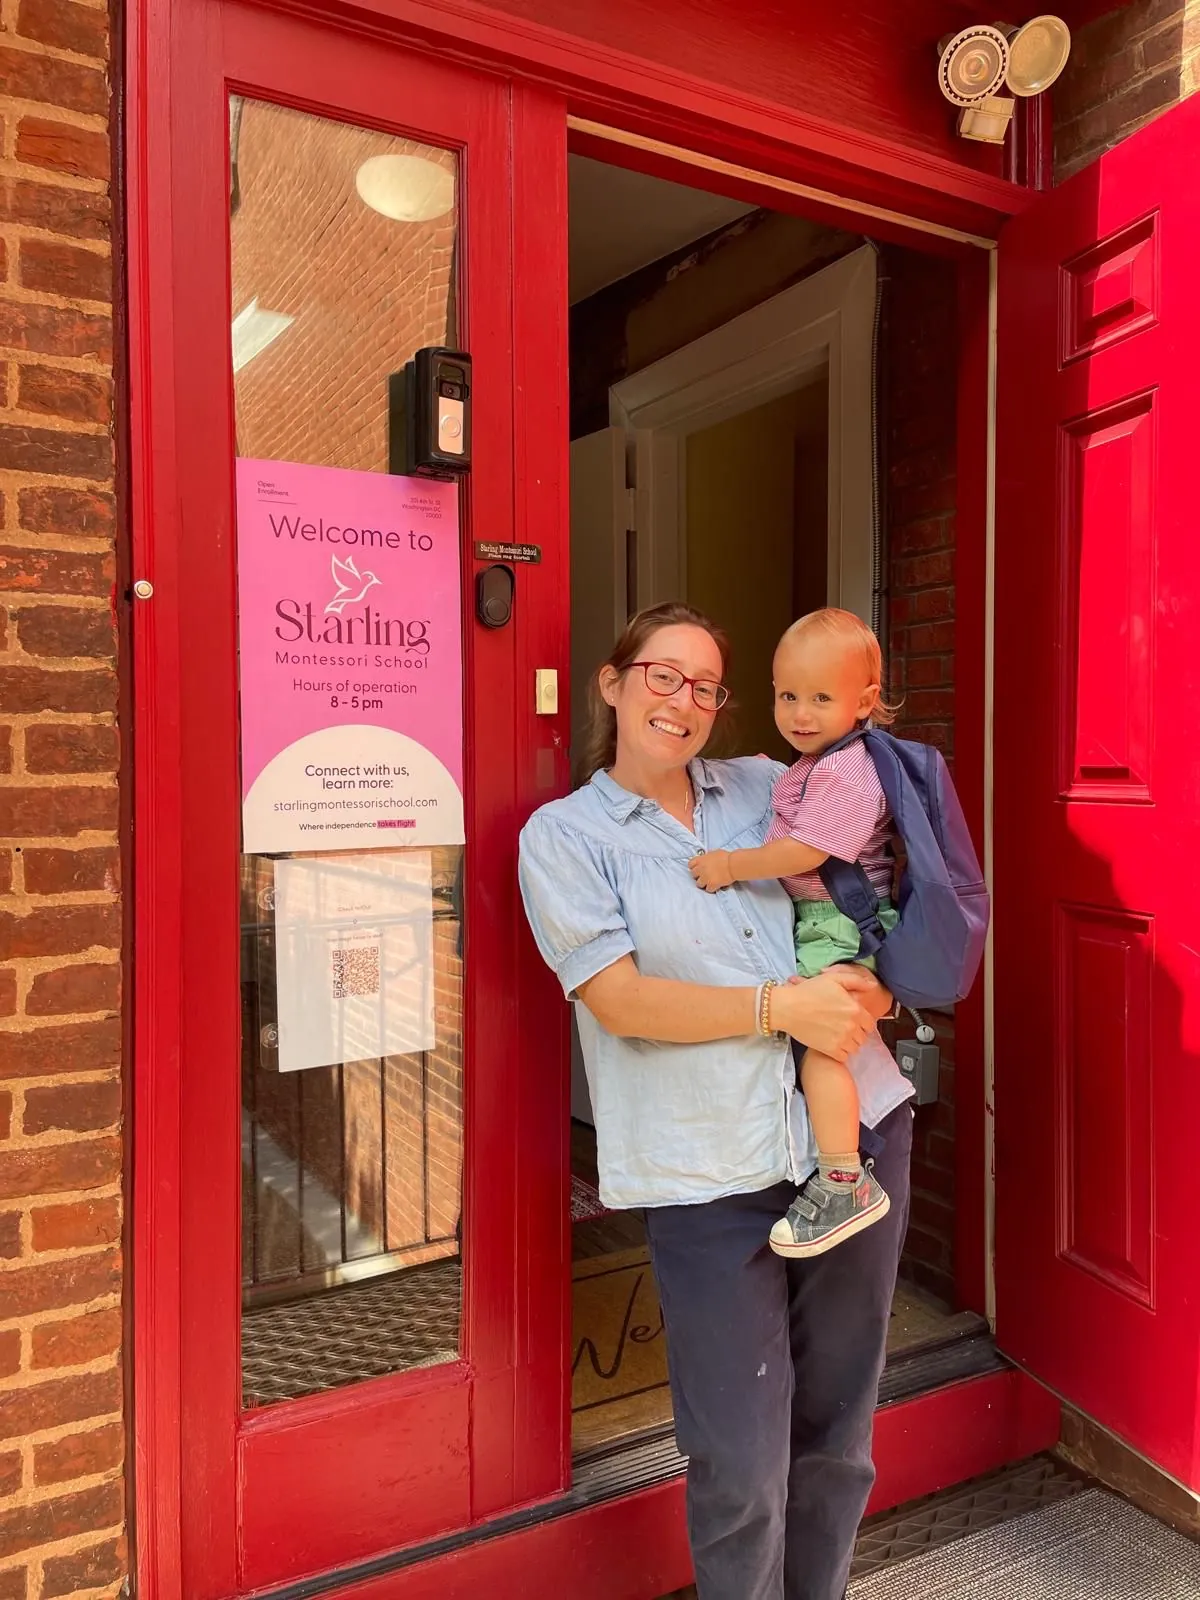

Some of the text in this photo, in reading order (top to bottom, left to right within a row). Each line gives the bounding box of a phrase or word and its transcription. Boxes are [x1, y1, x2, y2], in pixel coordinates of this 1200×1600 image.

[257, 480, 275, 488] Open
[257, 488, 289, 496] Enrollment
[269, 514, 433, 552] Welcome to
[522, 547, 537, 557] School
[275, 598, 431, 655] Starling
[275, 651, 429, 669] Montessori School
[293, 679, 417, 695] Hours of operation
[362, 698, 383, 711] pm
[305, 764, 410, 778] Connect with us,
[322, 777, 394, 790] learn more:
[273, 797, 438, 813] starlingmontessorischool.com
[298, 823, 324, 831] Where
[325, 821, 377, 831] independence
[377, 819, 396, 828] takes
